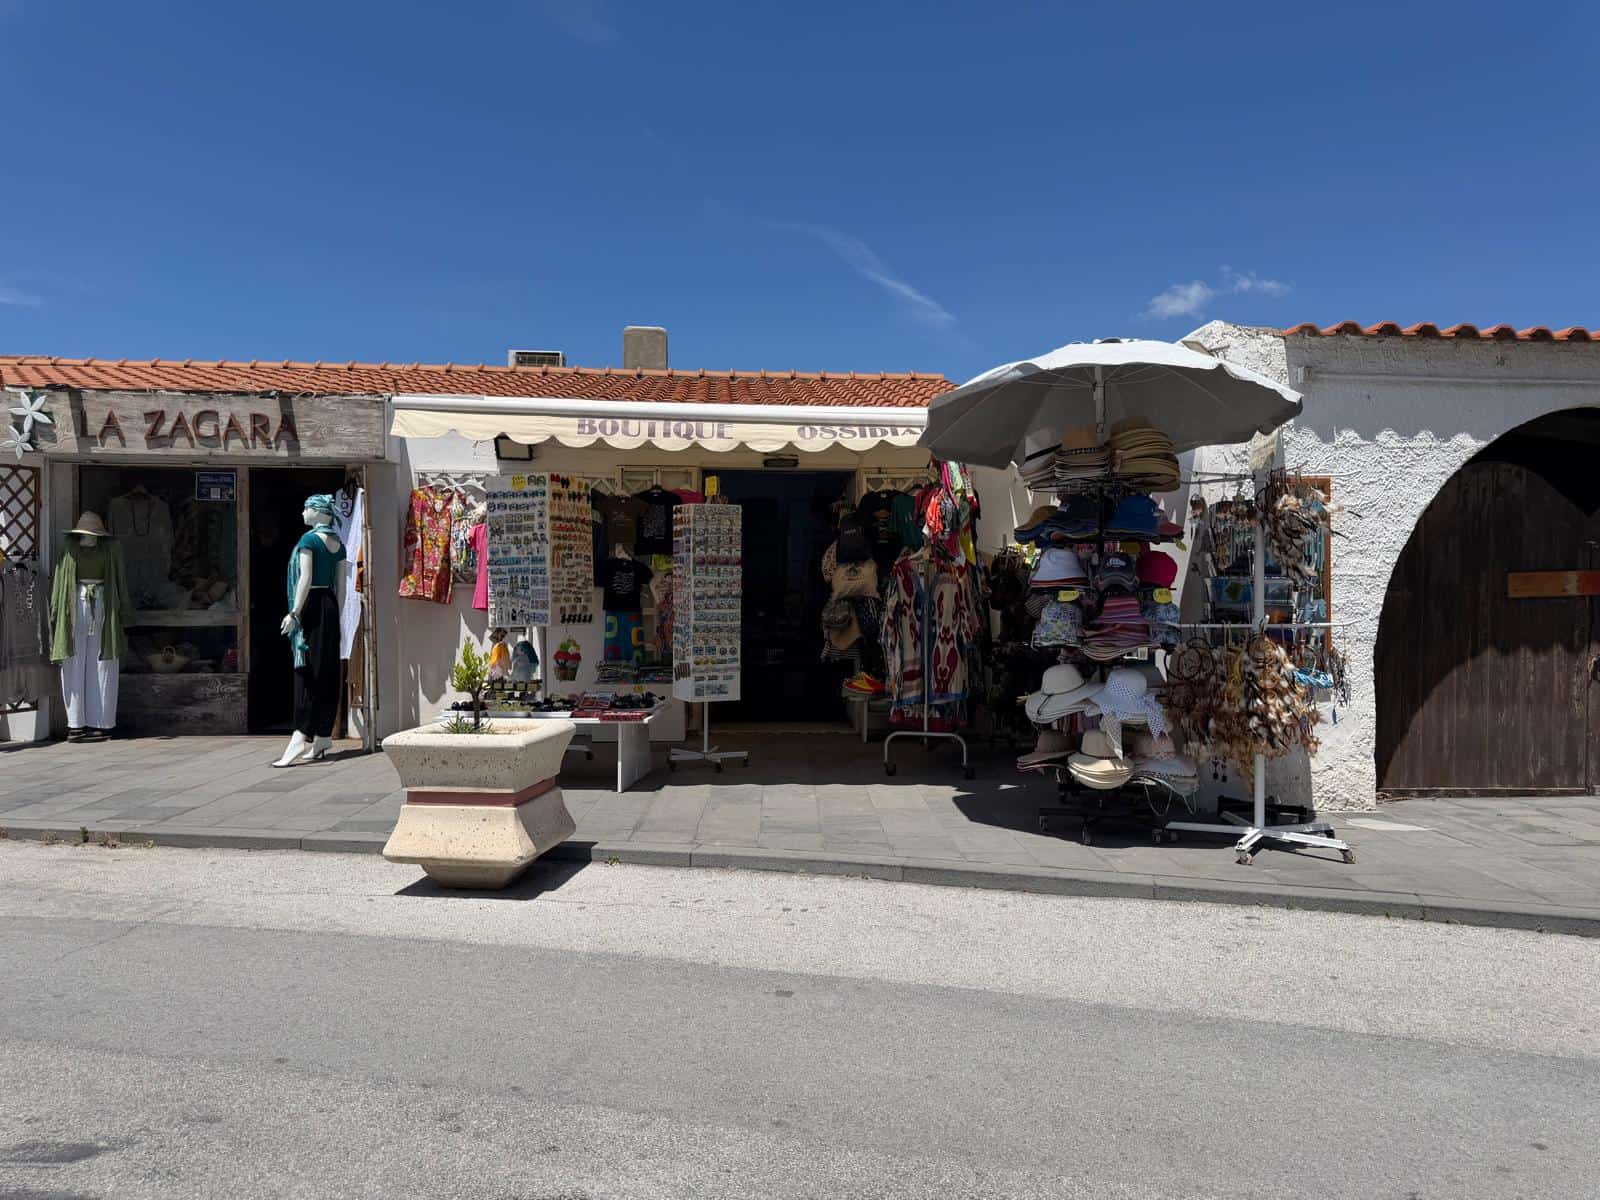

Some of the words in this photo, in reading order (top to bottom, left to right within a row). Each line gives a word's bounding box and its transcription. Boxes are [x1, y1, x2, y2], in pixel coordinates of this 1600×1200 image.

[79, 408, 125, 442] LA
[143, 408, 298, 442] ZAGARA
[576, 417, 735, 440] BOUTIQUE
[796, 425, 926, 440] OSSIDIA
